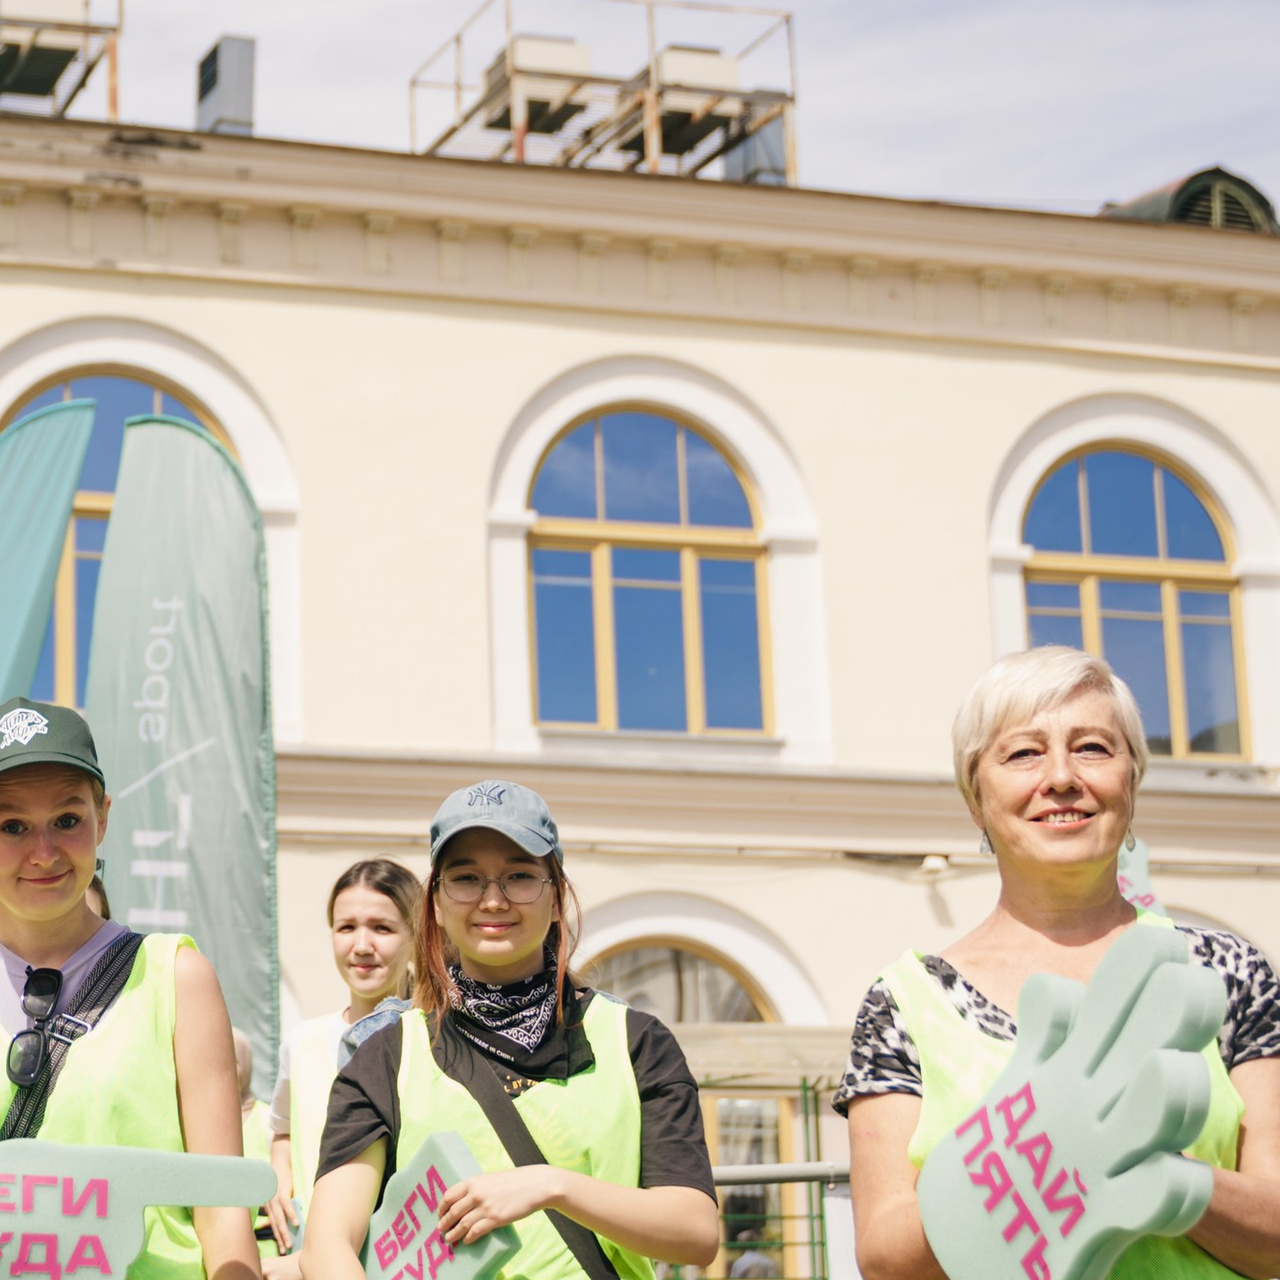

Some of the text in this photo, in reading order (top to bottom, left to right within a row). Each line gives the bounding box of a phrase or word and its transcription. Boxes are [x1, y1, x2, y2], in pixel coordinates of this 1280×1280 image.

[496, 1050, 515, 1062] CHINA
[511, 1078, 523, 1090] BY
[994, 1080, 1088, 1239] ДАЙ
[373, 1164, 448, 1271] БЕГИ
